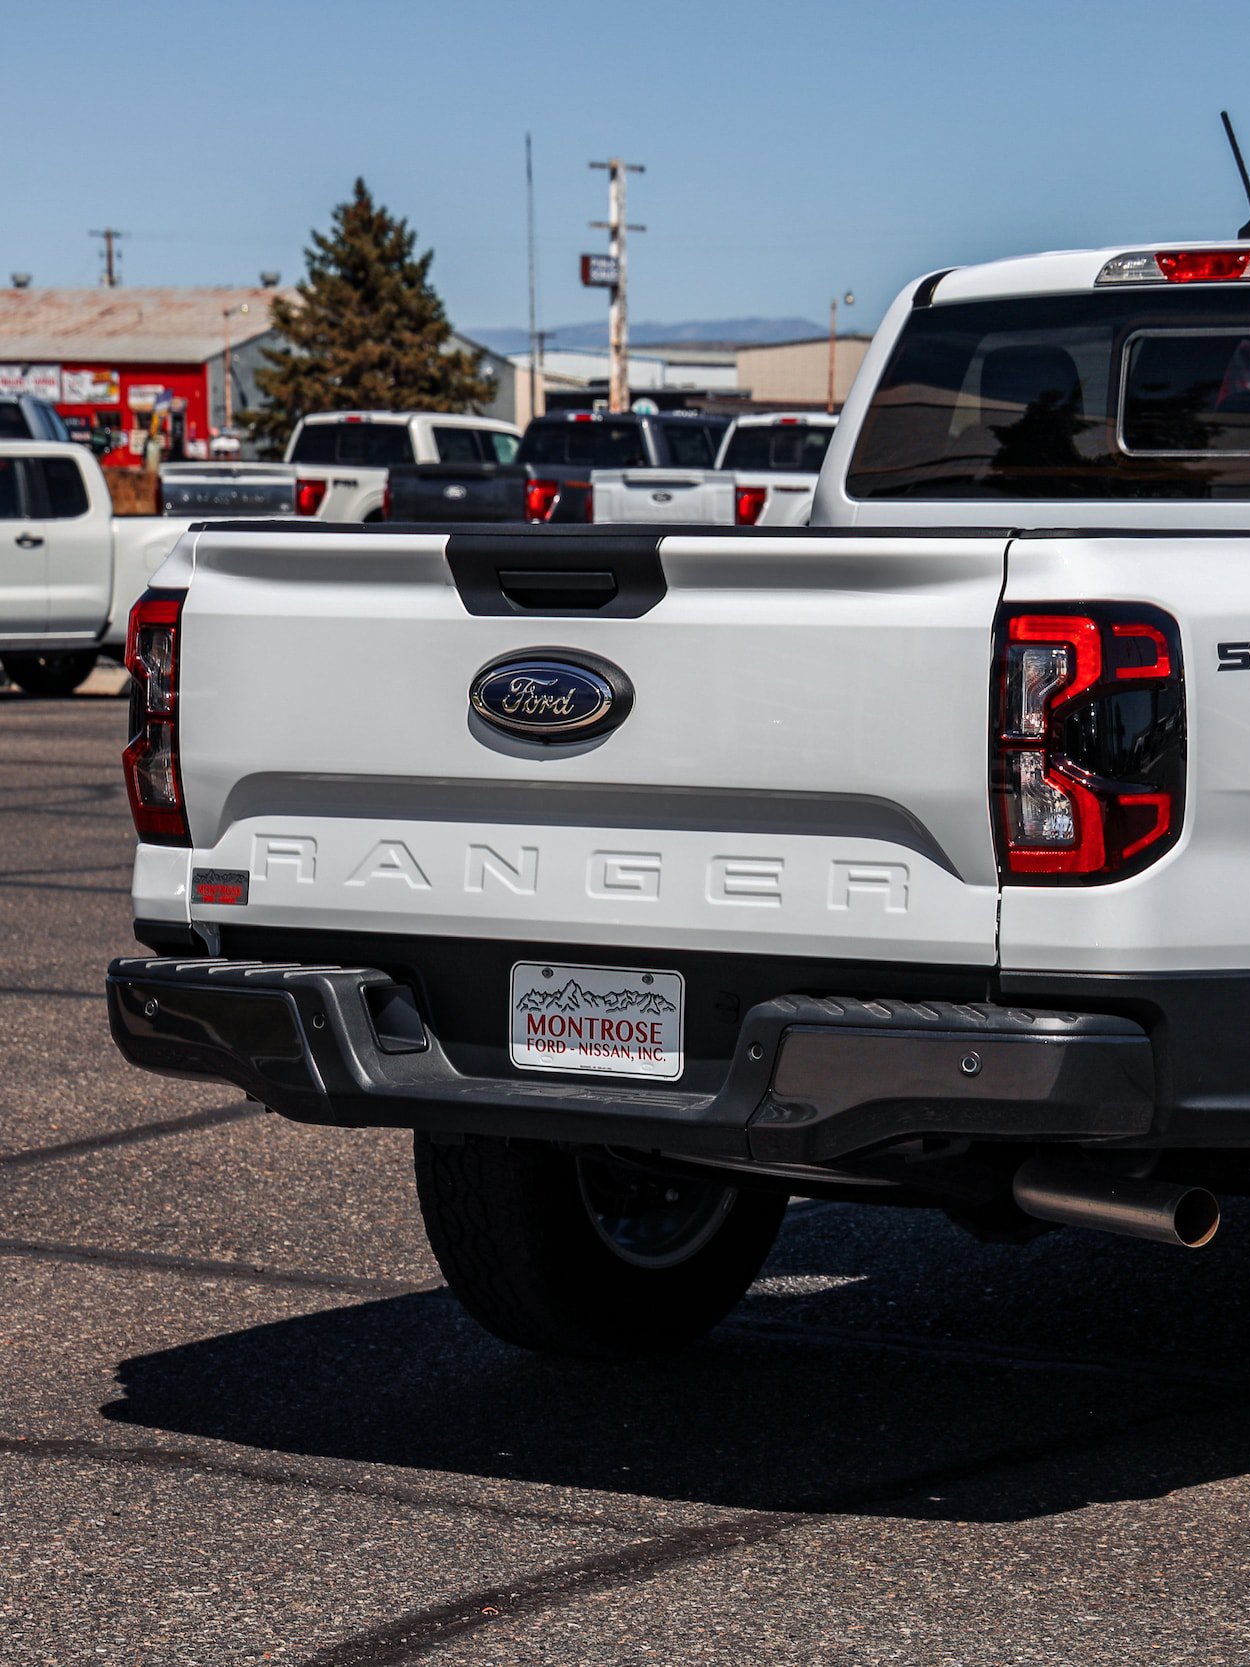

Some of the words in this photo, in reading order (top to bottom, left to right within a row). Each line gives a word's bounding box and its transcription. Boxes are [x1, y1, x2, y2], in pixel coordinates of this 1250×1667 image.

[502, 676, 577, 715] Ford
[250, 832, 911, 914] RANGER
[526, 1013, 664, 1045] MONTROSE
[527, 1037, 566, 1054] FORD
[579, 1041, 635, 1062] NISSAN,
[638, 1047, 667, 1062] INC.
